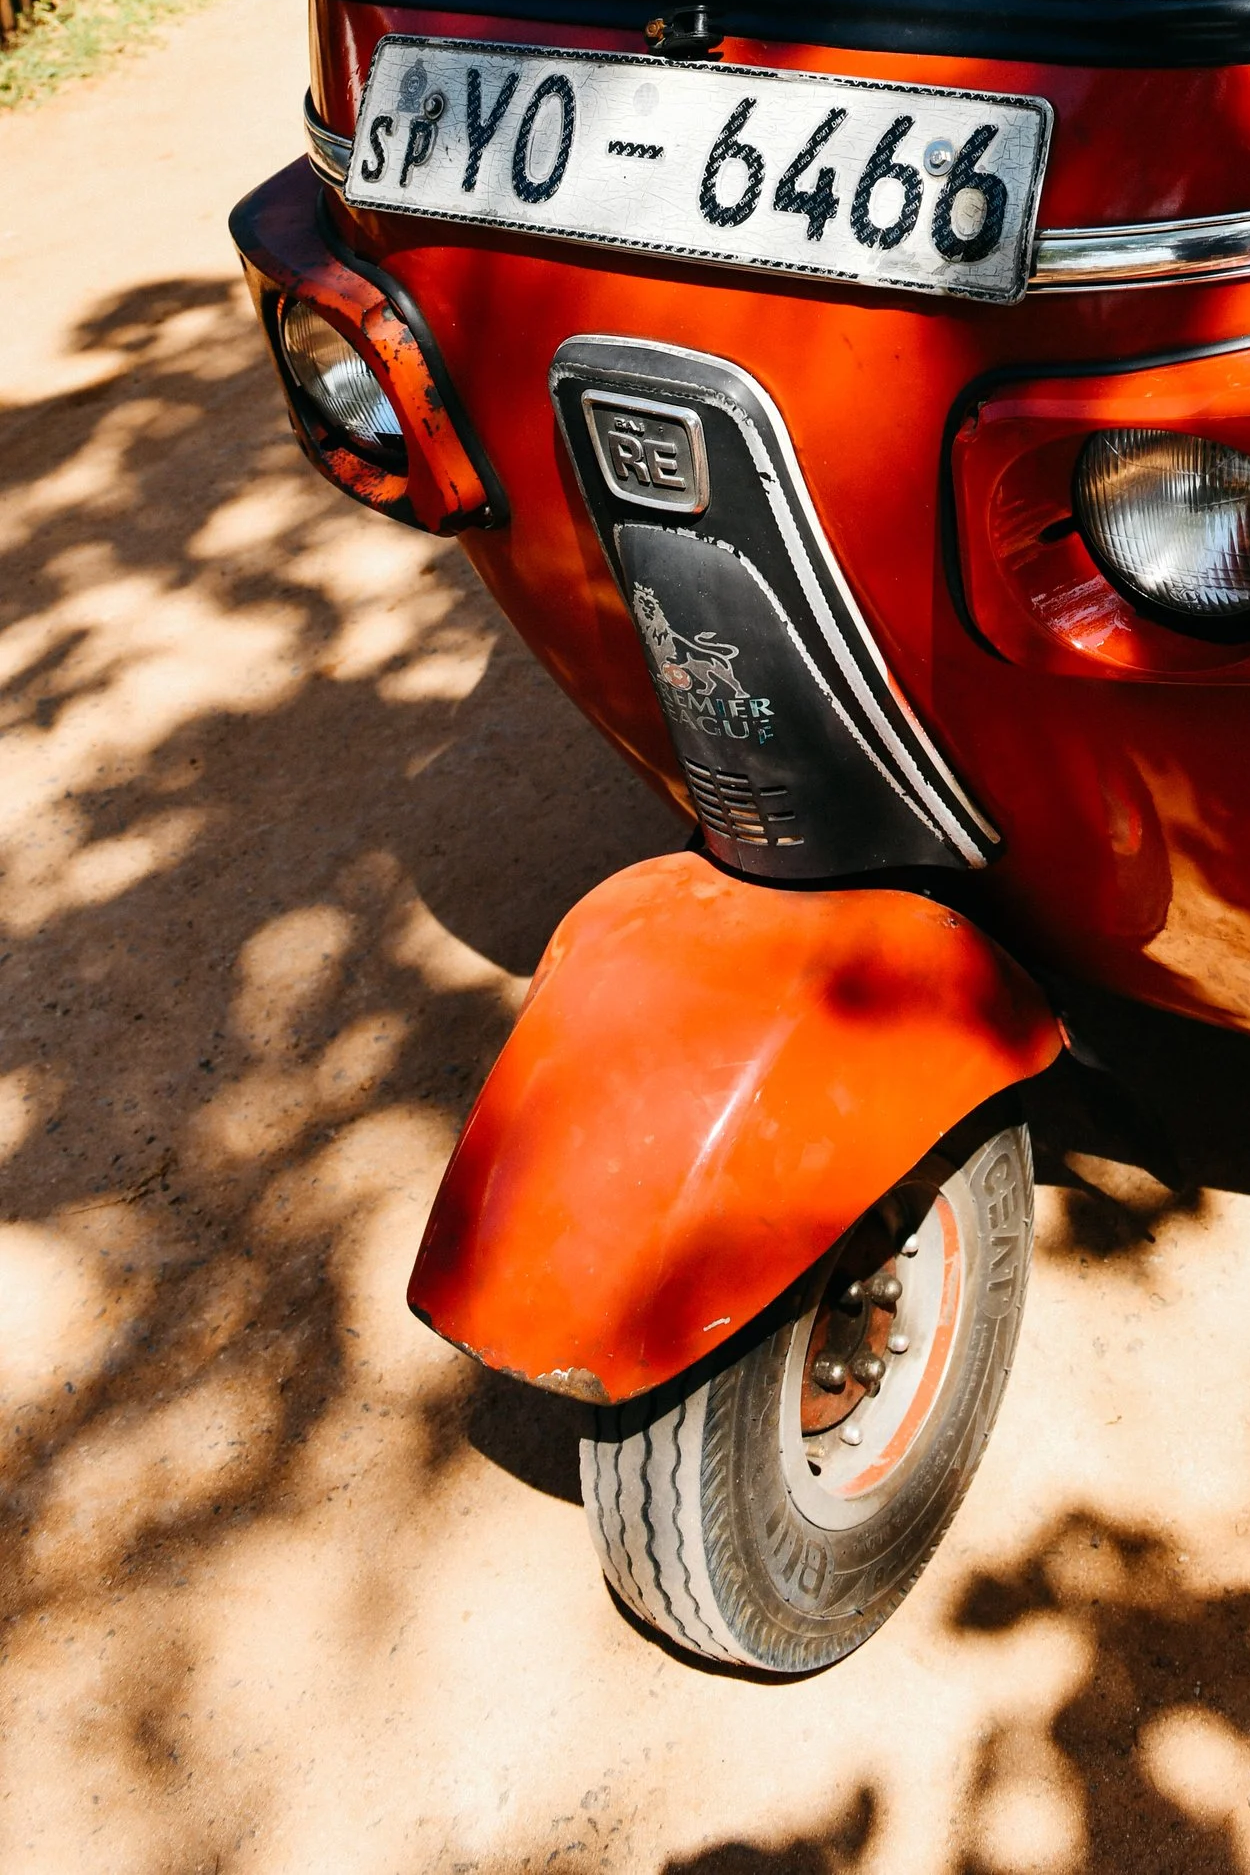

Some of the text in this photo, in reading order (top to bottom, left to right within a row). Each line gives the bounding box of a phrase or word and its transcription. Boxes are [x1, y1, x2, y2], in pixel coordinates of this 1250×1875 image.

[461, 67, 576, 204] YO
[699, 96, 1009, 264] 6466
[607, 430, 687, 492] RE
